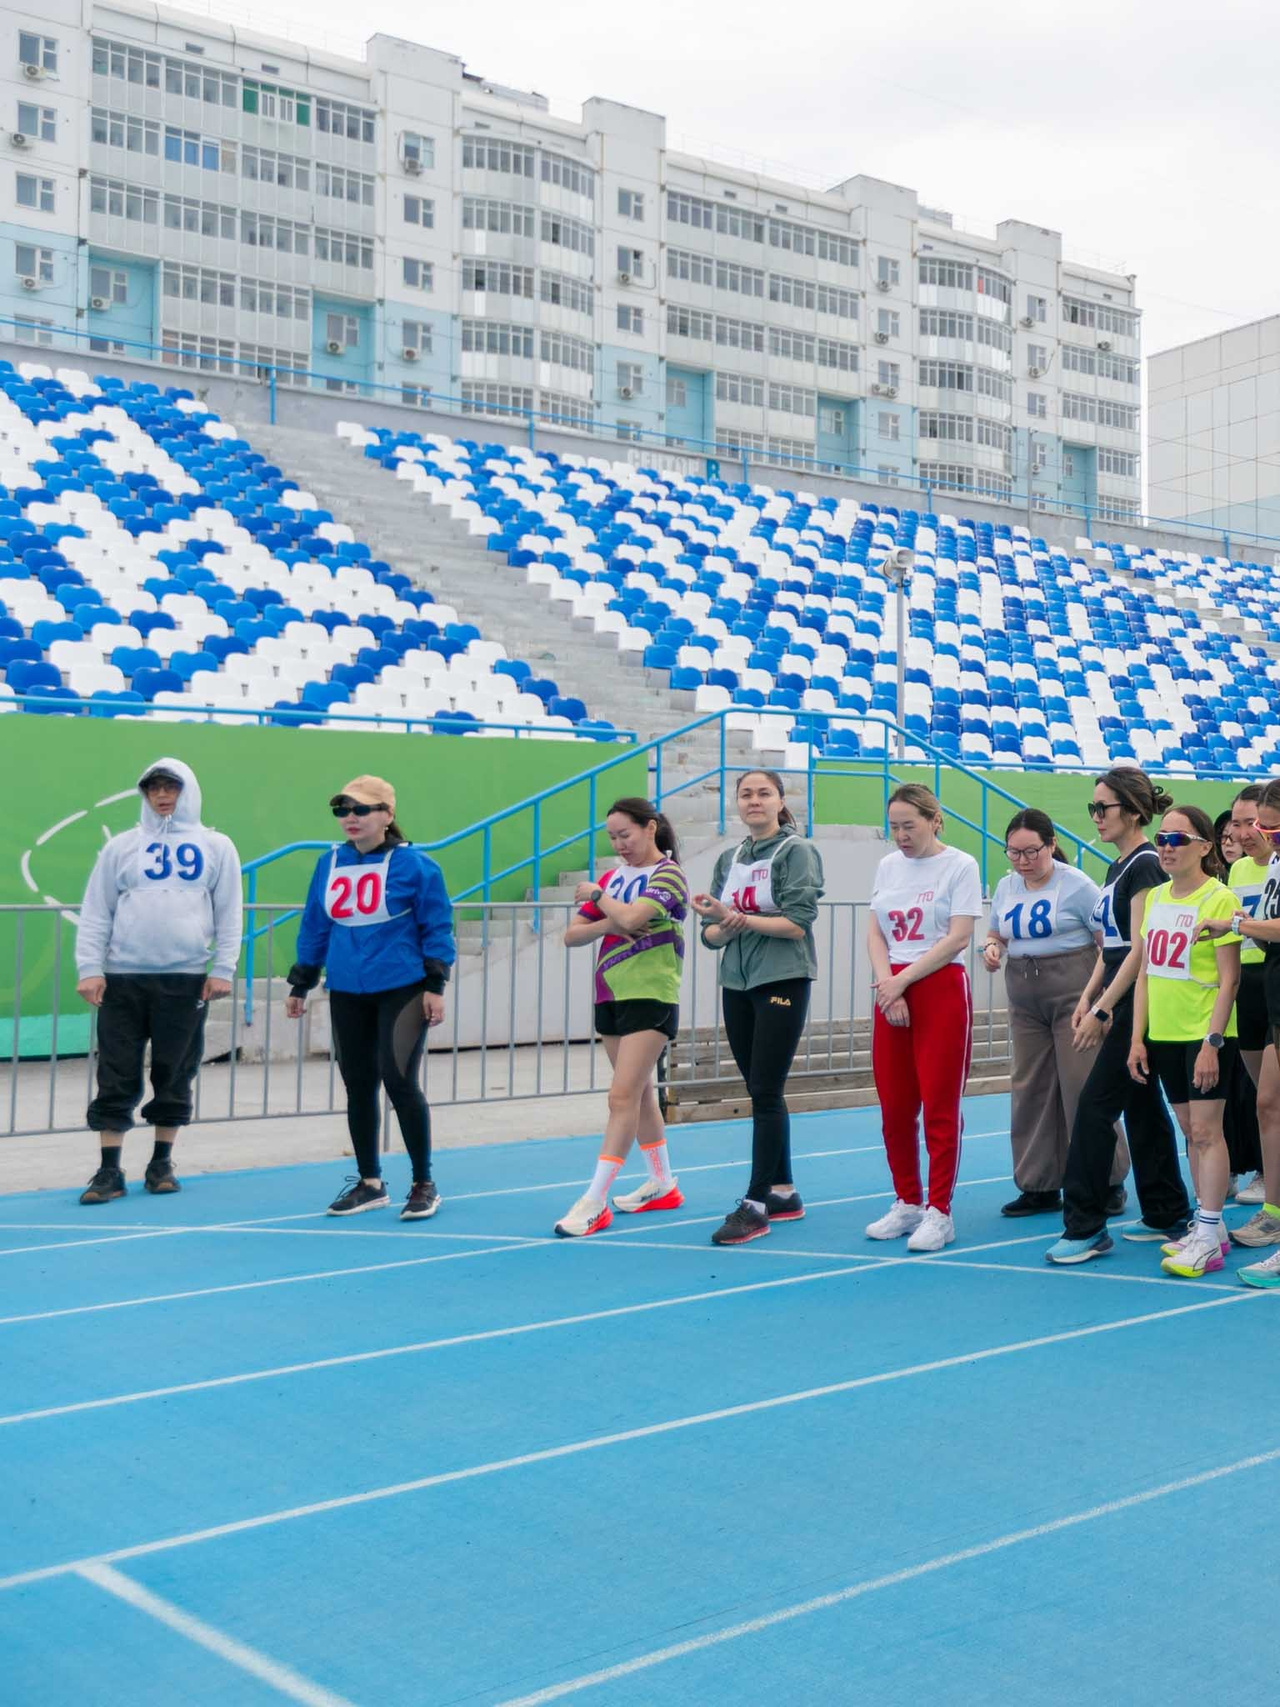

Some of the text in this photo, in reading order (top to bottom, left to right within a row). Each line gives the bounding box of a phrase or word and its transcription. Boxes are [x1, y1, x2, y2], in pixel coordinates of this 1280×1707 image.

[144, 842, 204, 881] 39
[330, 872, 382, 919] 20
[732, 886, 760, 913] 14
[888, 907, 925, 942] 32
[1004, 899, 1052, 940] 18
[1147, 929, 1188, 969] 102
[770, 996, 791, 1006] FILA
